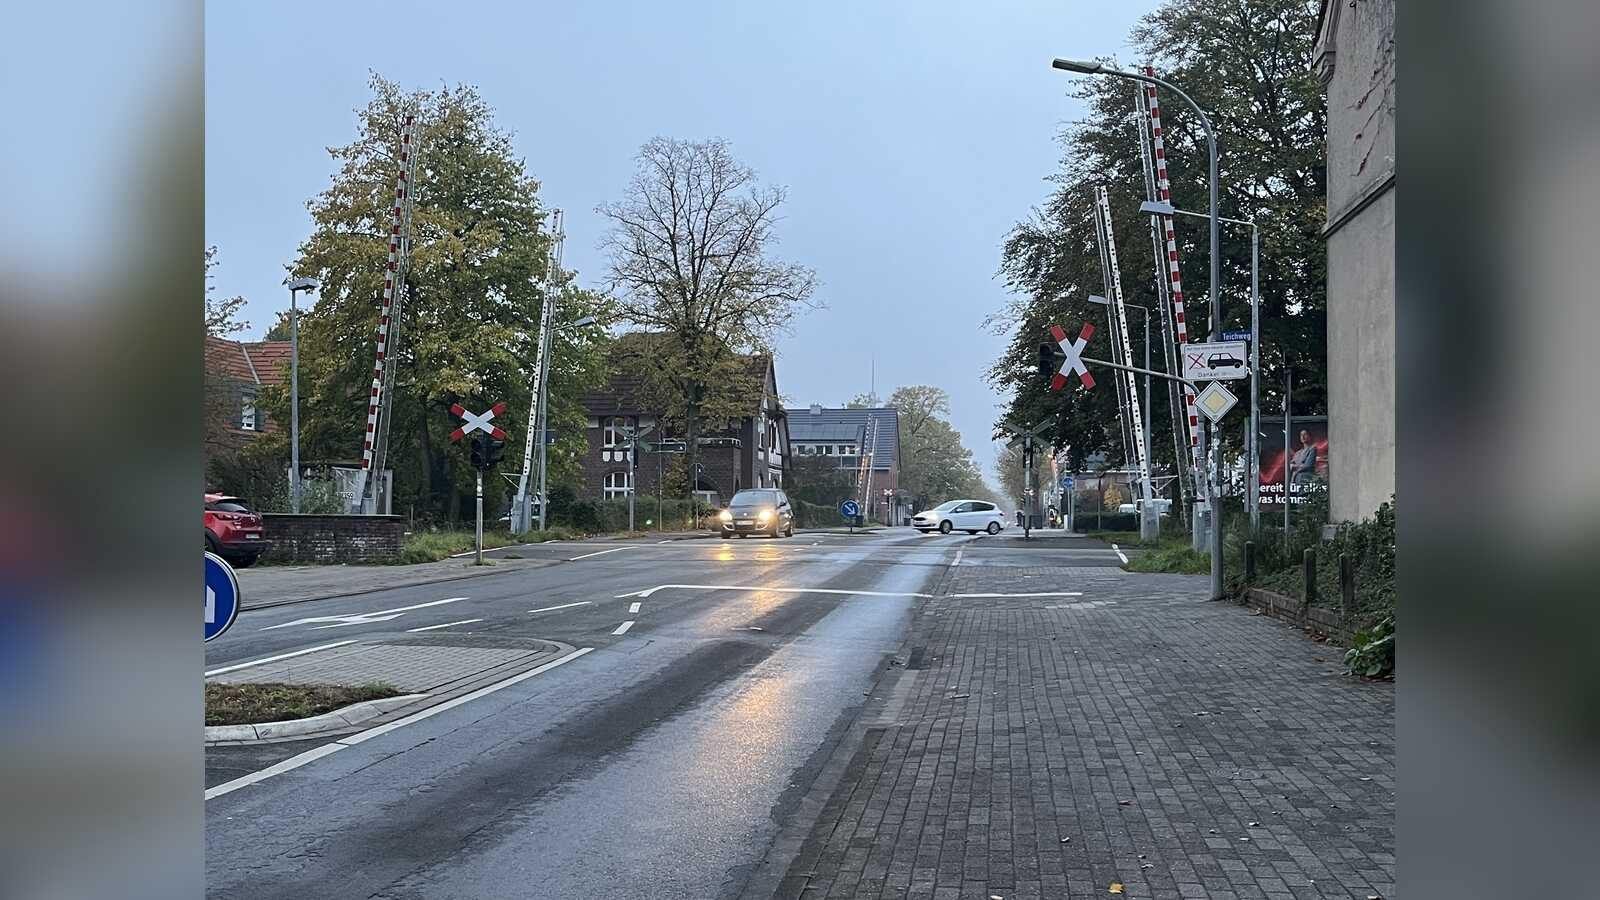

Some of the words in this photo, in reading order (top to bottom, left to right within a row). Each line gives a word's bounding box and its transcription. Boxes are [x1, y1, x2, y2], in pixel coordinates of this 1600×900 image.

[1222, 332, 1251, 341] Teichweg
[1257, 482, 1284, 493] ereit
[1288, 482, 1302, 493] ür
